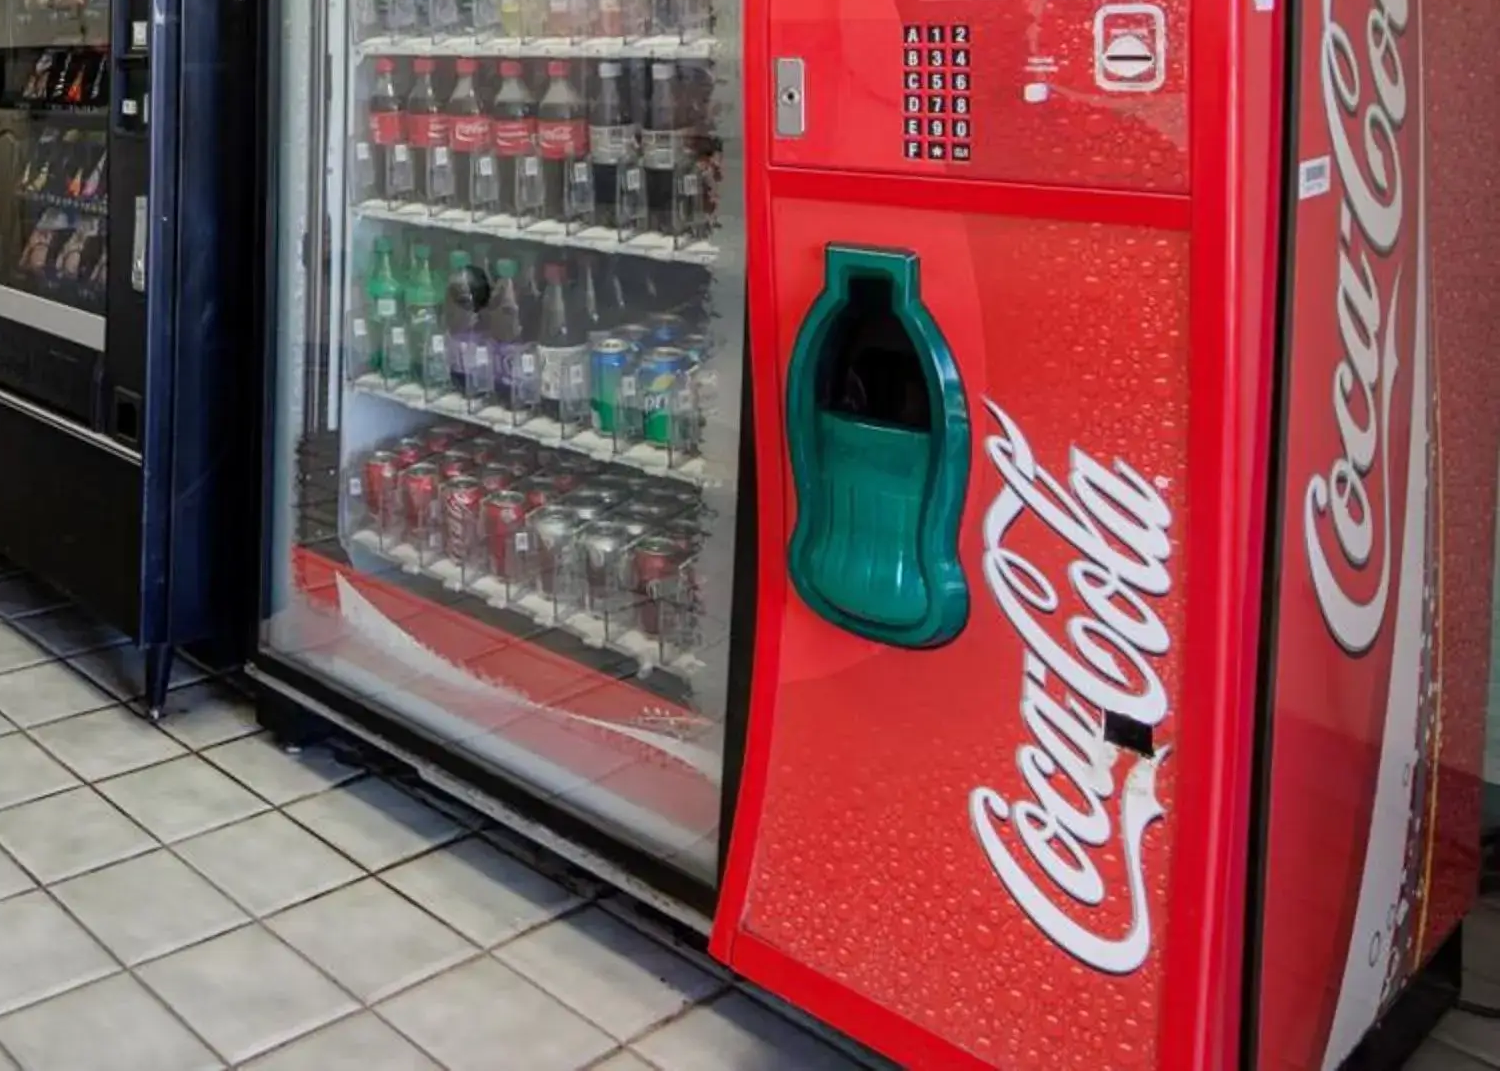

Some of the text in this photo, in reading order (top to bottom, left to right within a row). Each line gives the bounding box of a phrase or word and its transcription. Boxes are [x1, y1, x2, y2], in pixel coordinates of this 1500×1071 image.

[907, 26, 966, 42] A 1 2
[931, 50, 942, 66] 3
[955, 50, 966, 66] 4
[908, 72, 919, 89] C
[931, 74, 942, 89] 5
[931, 97, 942, 112] 7
[908, 118, 918, 134] E
[908, 141, 918, 158] F
[970, 395, 1173, 975] Coca-Cola
